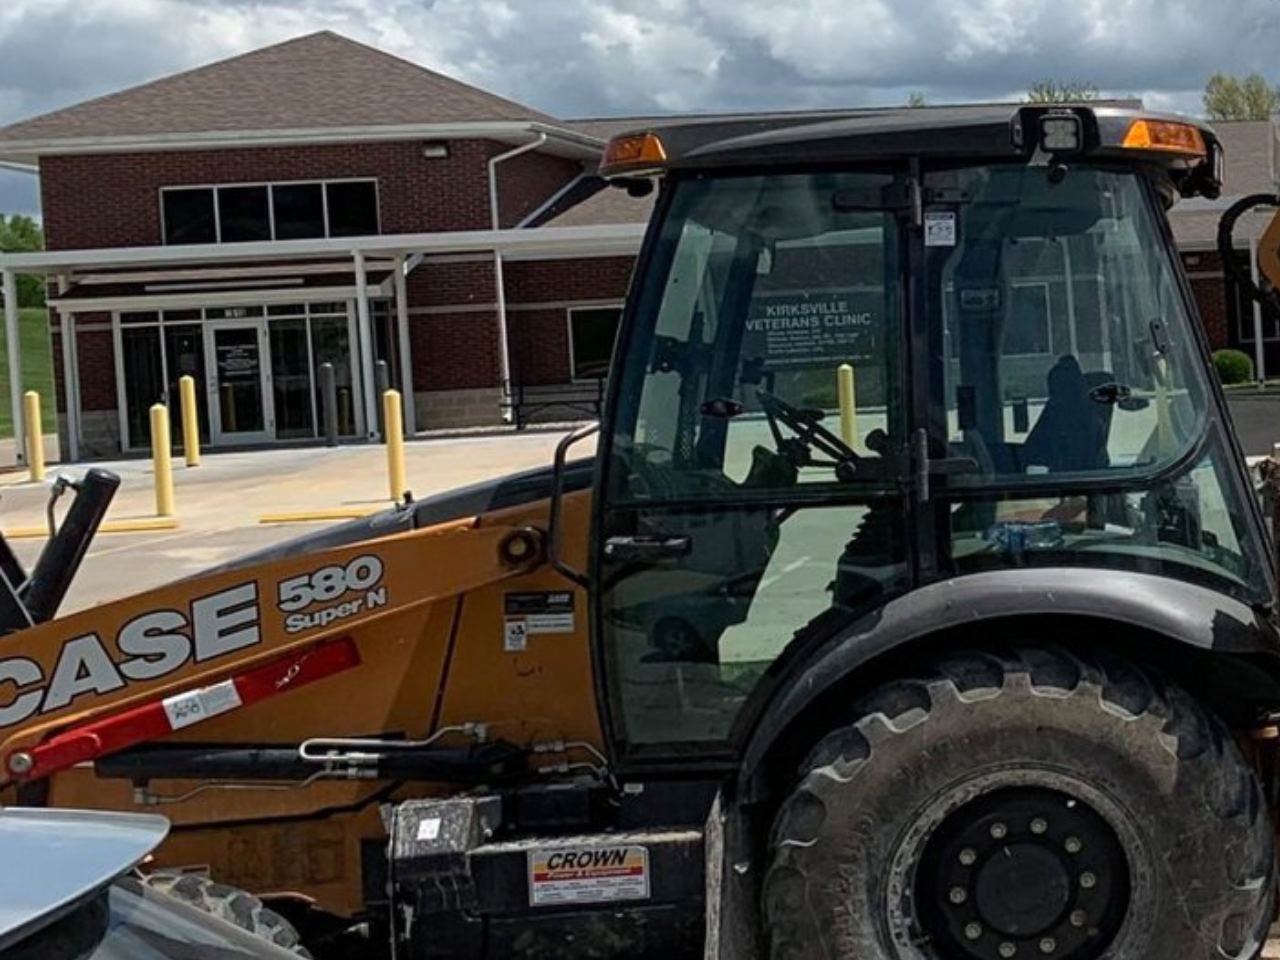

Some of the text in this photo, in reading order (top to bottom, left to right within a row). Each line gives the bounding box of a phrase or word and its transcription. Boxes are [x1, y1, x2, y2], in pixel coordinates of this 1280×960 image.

[745, 312, 871, 331] VETERANS CLINIC
[766, 301, 848, 317] KIRKSVILLE
[278, 554, 383, 611] 580
[285, 587, 386, 633] Super N
[0, 581, 261, 728] CASE
[546, 848, 628, 870] CROWN
